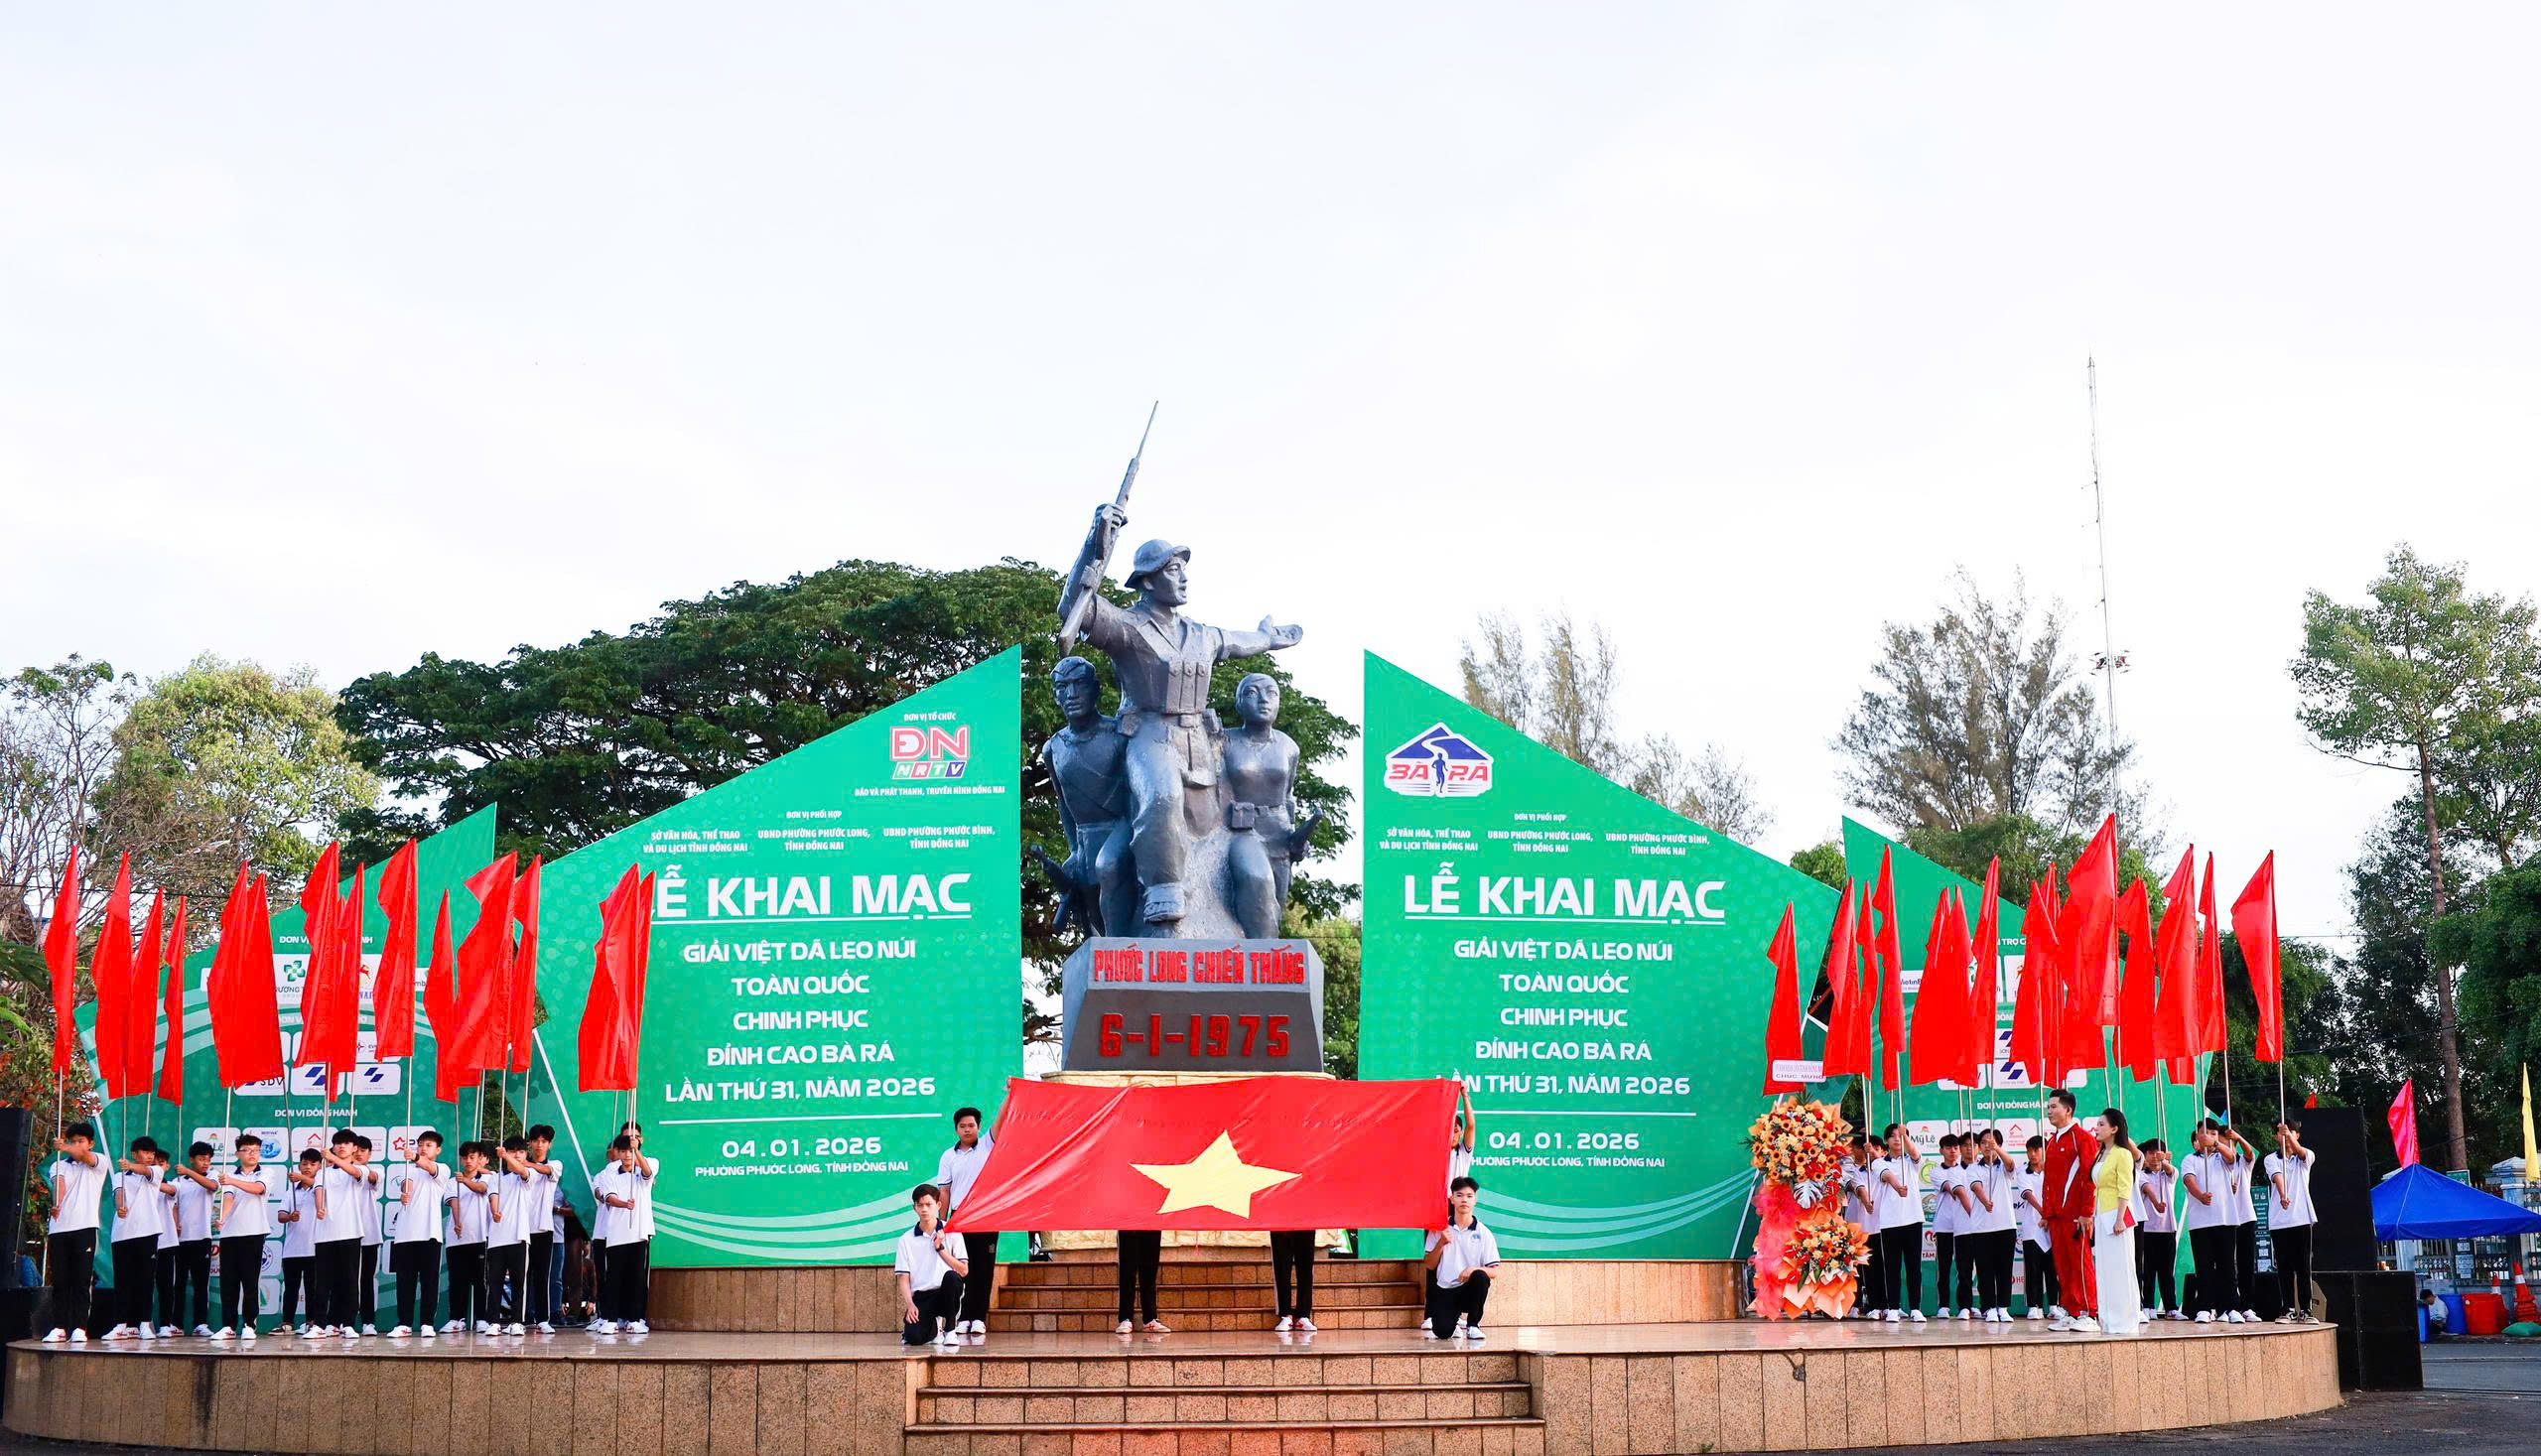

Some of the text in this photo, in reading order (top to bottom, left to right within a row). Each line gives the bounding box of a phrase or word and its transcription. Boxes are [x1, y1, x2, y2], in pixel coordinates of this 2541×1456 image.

[993, 785, 1005, 794] NAI
[719, 831, 740, 840] THAO
[757, 830, 781, 840] UBND
[782, 828, 817, 839] PHƯỜNG
[818, 827, 846, 838] PHƯỚC
[883, 828, 906, 837] UBND
[907, 826, 942, 837] PHƯỜNG
[943, 826, 970, 836] PHƯỚC
[1451, 829, 1471, 839] THAO
[1487, 830, 1510, 840] UBND
[1511, 830, 1543, 840] PHƯỜNG
[1544, 830, 1570, 841] PHƯỚC
[1605, 833, 1628, 842] UBND
[1629, 832, 1661, 843] PHƯỜNG
[1662, 833, 1687, 844] PHƯỚC
[643, 843, 654, 854] VÀ
[655, 844, 667, 854] DU
[668, 844, 687, 855] LỊCH
[709, 841, 733, 853] ĐỒNG
[734, 843, 747, 852] NAI
[805, 840, 828, 851] ĐỒNG
[830, 841, 845, 851] NAI
[931, 837, 954, 849] ĐỒNG
[955, 839, 969, 848] NAI
[1379, 840, 1390, 850] VÀ
[1391, 841, 1402, 851] DU
[1404, 841, 1420, 852] LỊCH
[1442, 841, 1463, 851] ĐỒNG
[1464, 843, 1478, 852] NAI
[1533, 842, 1554, 853] ĐỒNG
[1651, 846, 1672, 856] ĐỒNG
[1672, 847, 1685, 856] NAI
[652, 863, 973, 920] Ễ KHAI MẠC
[1404, 861, 1726, 924] LỄ KHAI MẠC
[683, 936, 916, 965] GIẢI VIỆT DÃ LEO NÚI
[1453, 936, 1672, 962] GIẢI VIỆT DÃ LEO NÚI
[1094, 942, 1305, 985] PHƯỚC LONG CHIẾN THẮNG
[732, 969, 869, 995] TOÀN QUỐC
[1499, 969, 1629, 993] TOÀN QUỐC
[734, 1009, 869, 1032] CHINH PHỤC
[1500, 1007, 1628, 1029] CHINH PHỤC
[1099, 1012, 1290, 1057] 6-1-1975
[707, 1039, 894, 1066] ĐỈNH CAO BÀ RÁ
[1475, 1036, 1652, 1061] ĐỈNH CAO BÀ RÁ
[665, 1076, 936, 1103] LẦN THỨ 31, NĂM 2026
[1485, 1072, 1532, 1093] THỨ
[1536, 1075, 1563, 1095] 31,
[1568, 1073, 1620, 1094] NĂM
[1625, 1076, 1690, 1095] 2026
[722, 1136, 881, 1158] 04.01.2026
[1489, 1131, 1640, 1150] 04.01.2026
[695, 1164, 745, 1177] PHƯỜNG
[745, 1163, 787, 1175] PHƯỚC
[853, 1159, 887, 1172] ĐỒNG
[888, 1160, 908, 1172] NAI
[1472, 1155, 1510, 1167] HƯỜNG
[1512, 1155, 1550, 1167] PHƯỚC
[1613, 1154, 1645, 1167] ĐỒNG
[1646, 1157, 1666, 1168] NAI
